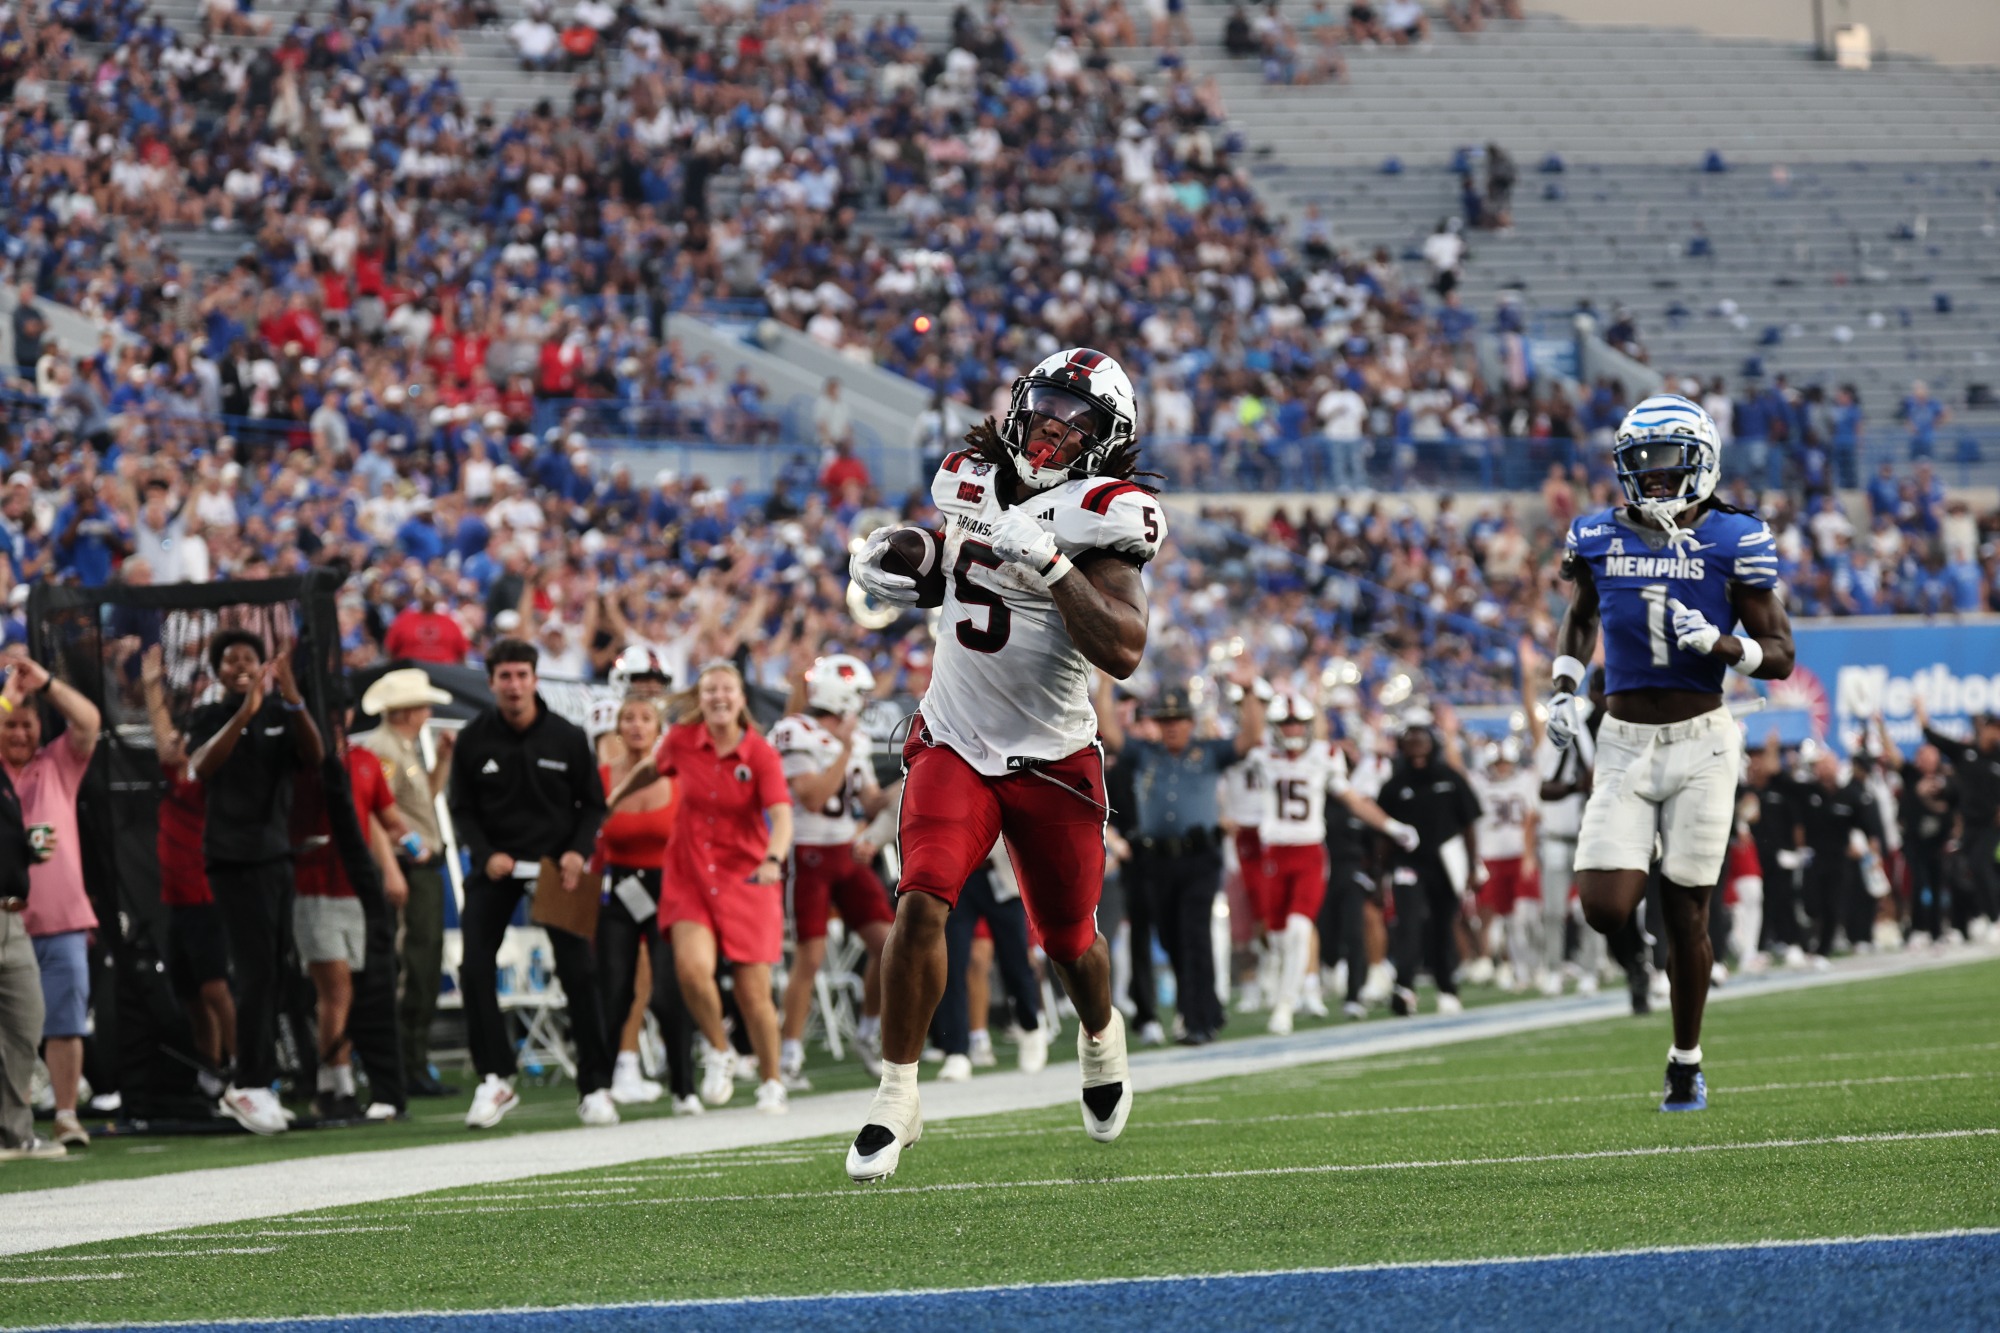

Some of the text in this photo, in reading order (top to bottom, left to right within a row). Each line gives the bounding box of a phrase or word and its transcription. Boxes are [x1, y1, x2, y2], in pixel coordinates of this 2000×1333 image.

[1142, 506, 1159, 543] 5
[1580, 524, 1617, 539] FedEx
[1605, 556, 1705, 580] MEMPHIS
[953, 538, 1011, 654] 5
[1639, 582, 1672, 668] 1
[1837, 663, 2000, 717] Metho
[1275, 778, 1310, 821] 15
